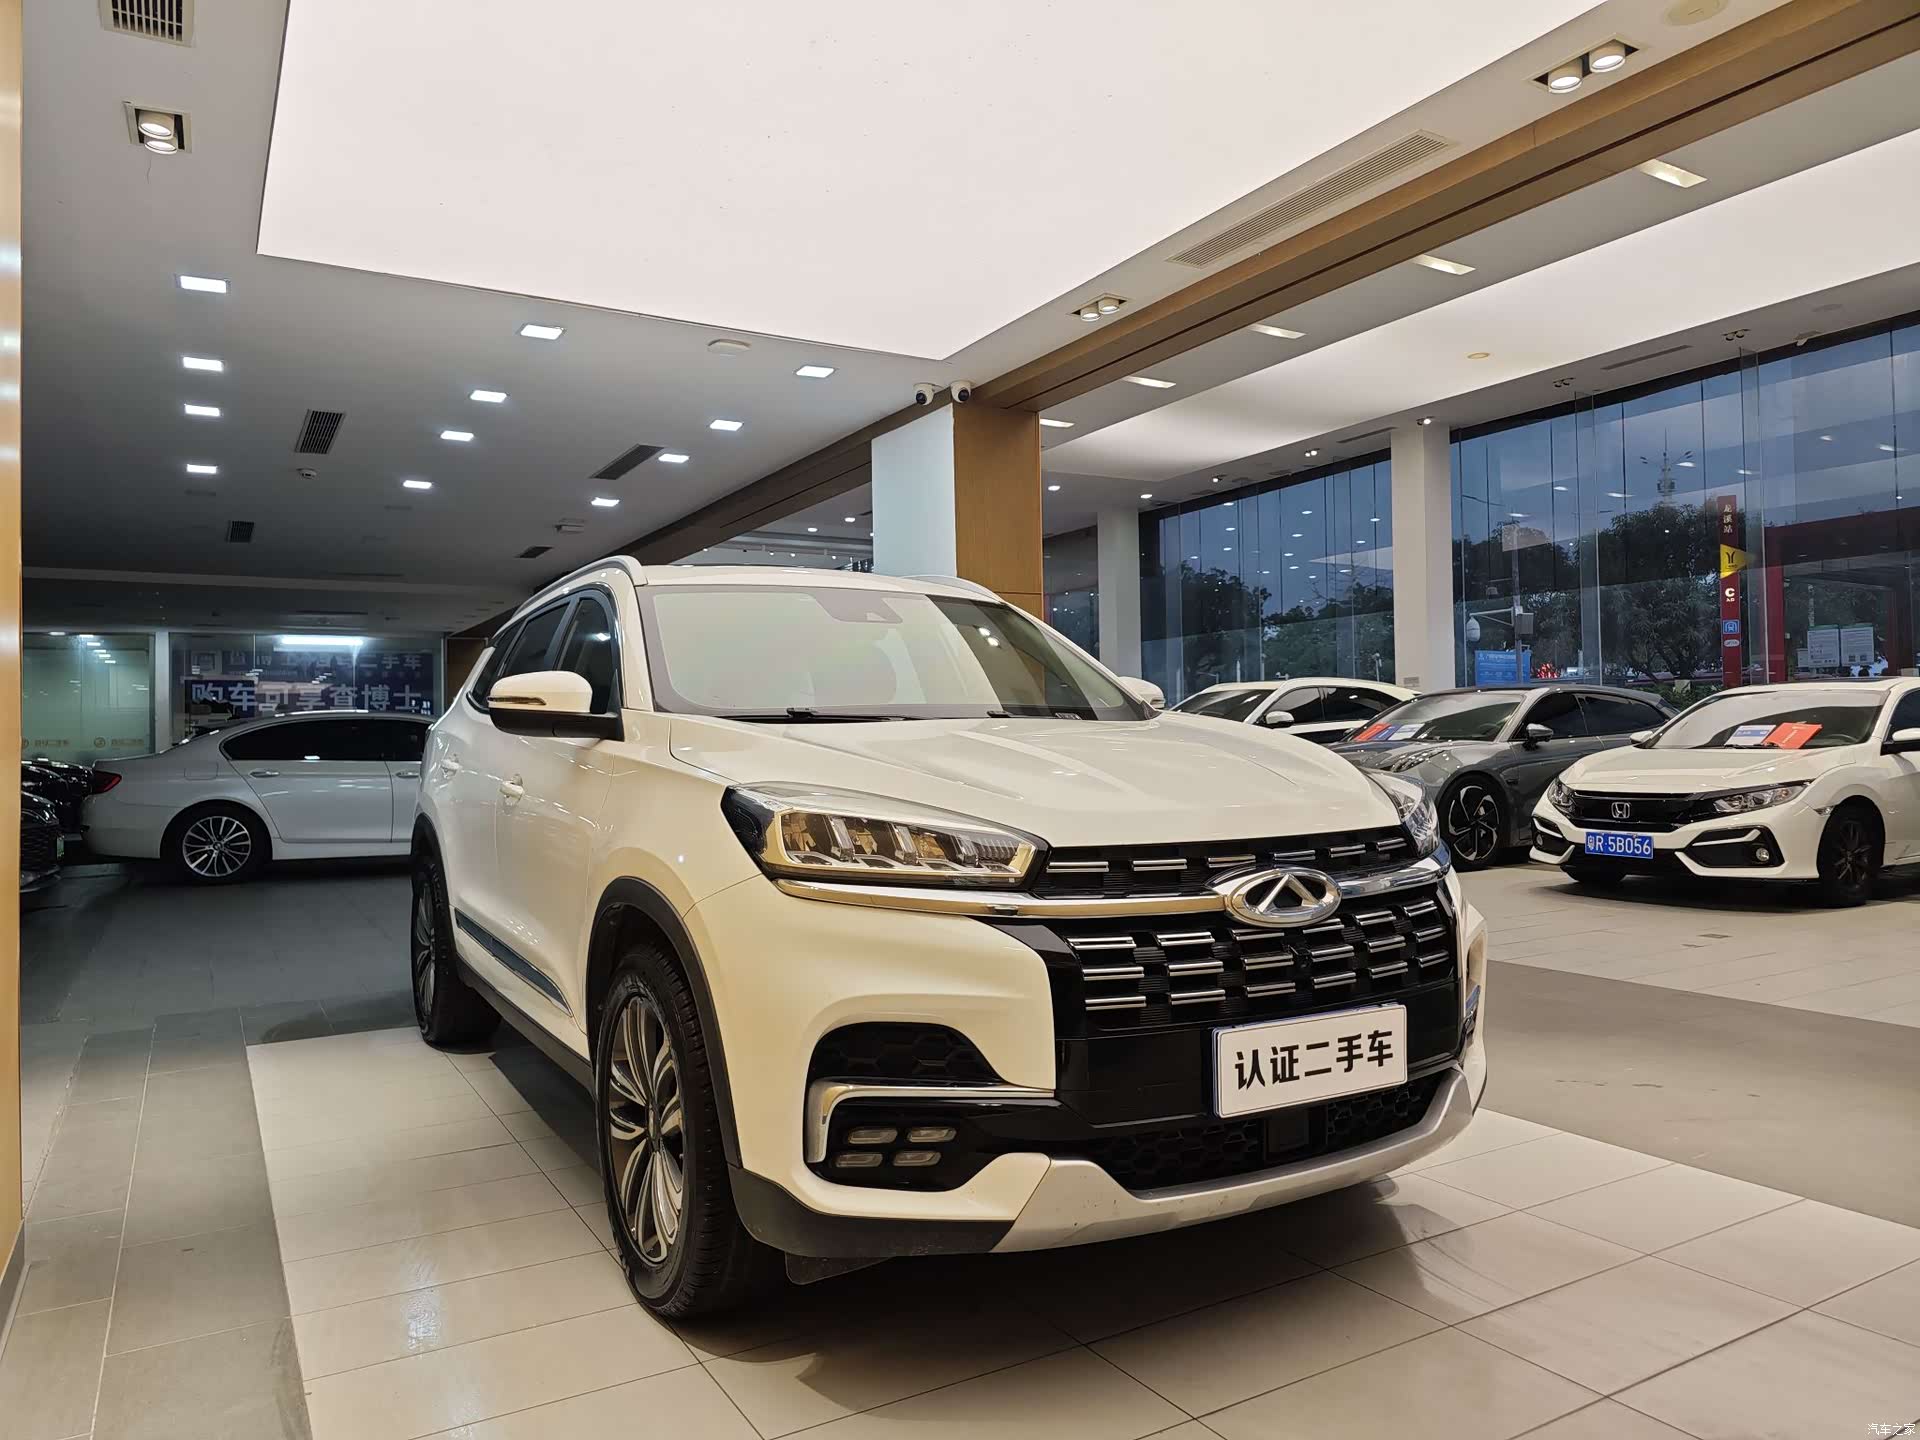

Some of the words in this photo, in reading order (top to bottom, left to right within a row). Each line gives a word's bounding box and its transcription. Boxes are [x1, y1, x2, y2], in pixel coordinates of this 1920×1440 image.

[1725, 587, 1735, 597] C
[1235, 1030, 1393, 1090] 认证二手车
